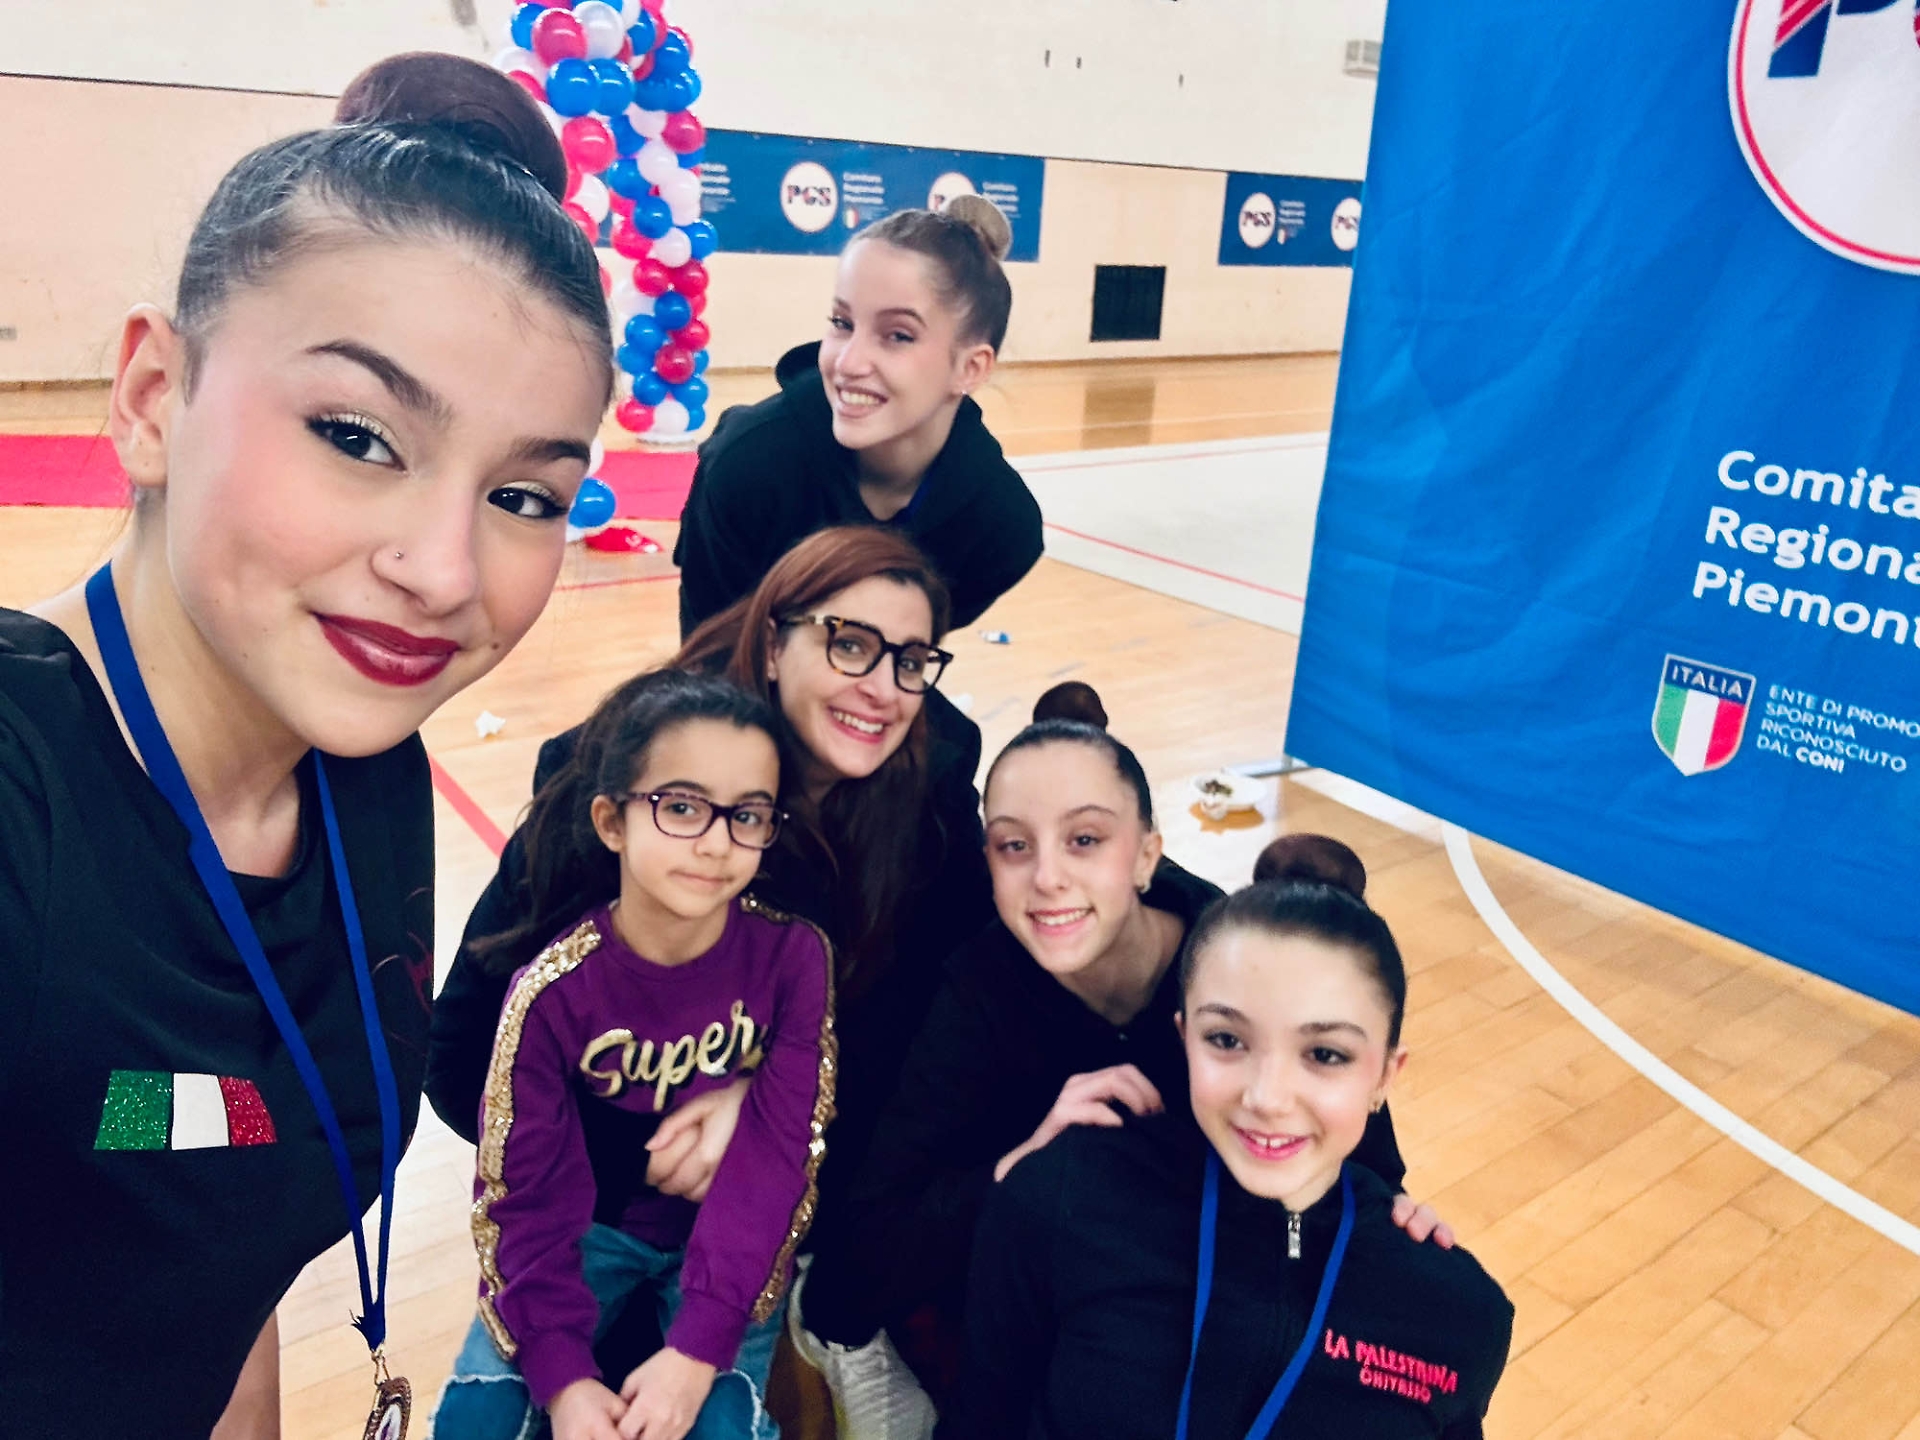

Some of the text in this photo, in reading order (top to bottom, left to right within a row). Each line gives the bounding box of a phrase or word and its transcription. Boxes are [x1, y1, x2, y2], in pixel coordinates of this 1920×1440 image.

[787, 184, 831, 207] PGS
[1692, 560, 1920, 650] Piemon
[1671, 664, 1744, 699] ITALIA
[1765, 701, 1857, 739] SPORTIVA
[1769, 684, 1920, 738] ENTE DI PROMO
[1756, 734, 1846, 774] DAL CONI
[1760, 718, 1908, 773] RICONOSCIUTO
[579, 999, 768, 1113] Super
[1324, 1328, 1351, 1360] LA
